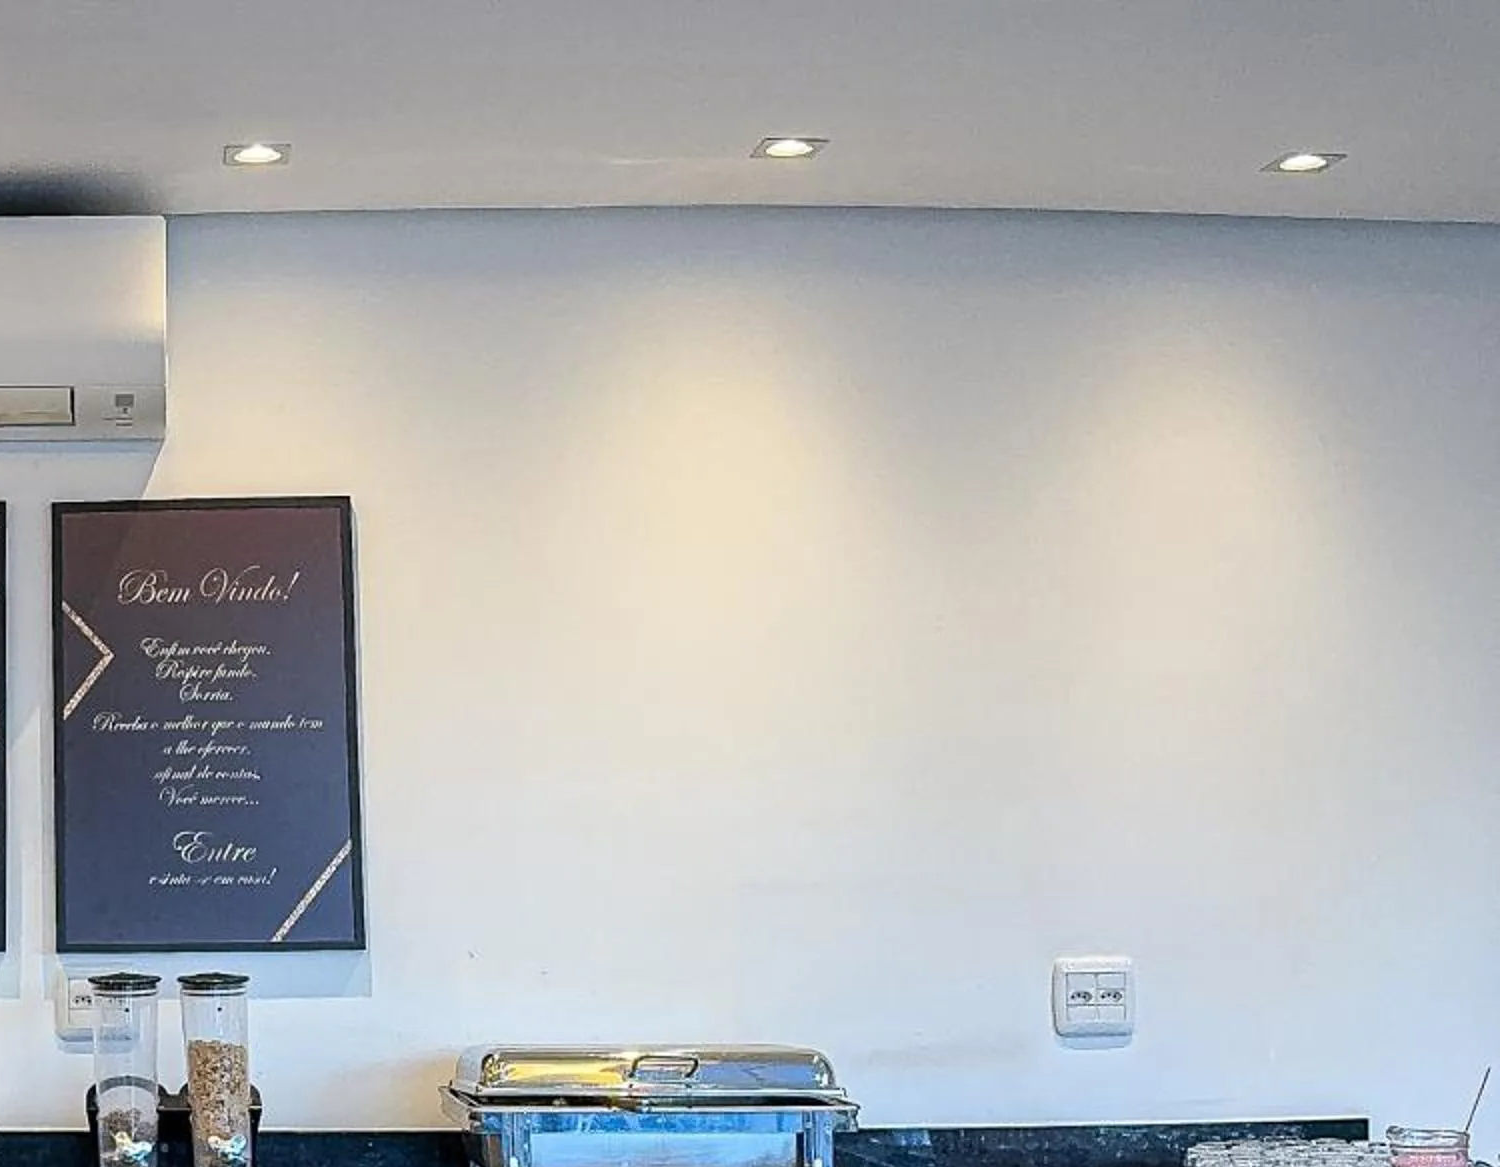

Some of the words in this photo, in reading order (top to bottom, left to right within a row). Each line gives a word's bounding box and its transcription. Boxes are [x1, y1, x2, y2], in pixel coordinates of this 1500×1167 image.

[117, 568, 192, 605] Bem
[200, 564, 301, 605] Vindo!
[140, 637, 191, 661] Enfim
[173, 830, 258, 864] Entre
